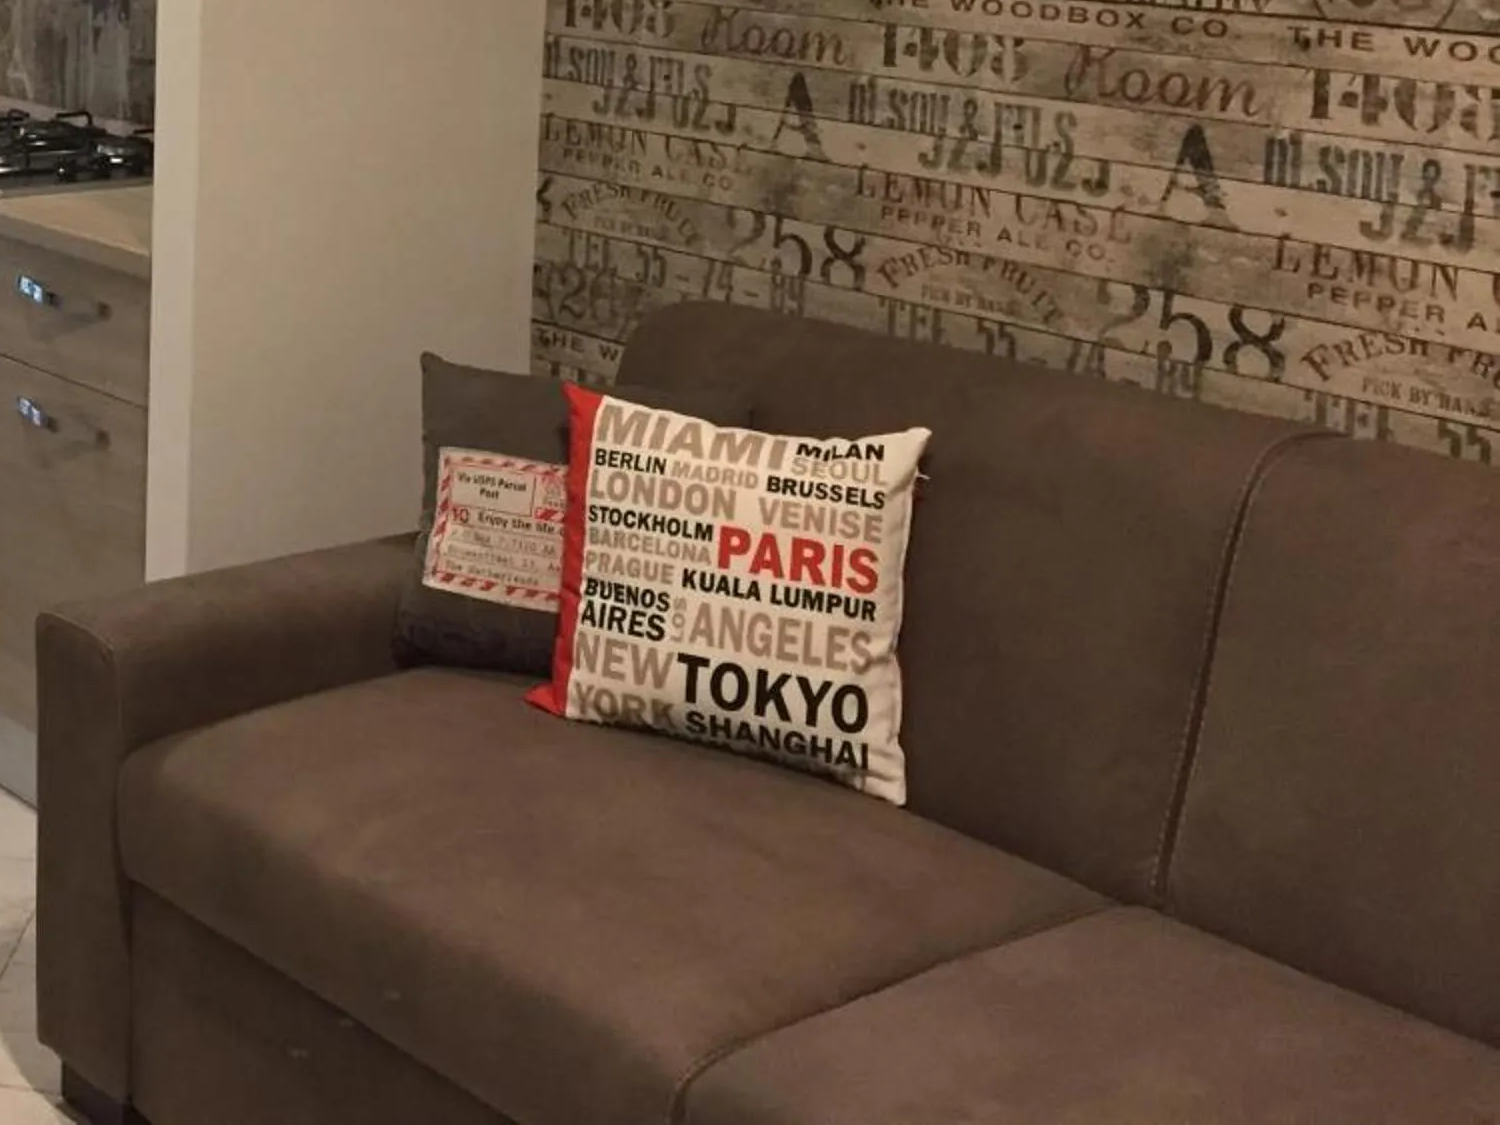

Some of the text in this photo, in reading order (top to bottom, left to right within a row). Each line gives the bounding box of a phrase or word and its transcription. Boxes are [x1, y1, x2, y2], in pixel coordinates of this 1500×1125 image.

[1289, 26, 1377, 57] THE
[1062, 41, 1263, 119] Room
[1159, 118, 1243, 229] A
[1302, 280, 1450, 326] PEPPER
[1091, 275, 1290, 385] 258
[597, 405, 788, 470] MIAMI
[796, 443, 885, 462] MILAN
[594, 448, 759, 490] BERLIN MADRID
[766, 474, 886, 510] BRUSSELS
[790, 455, 887, 487] SEOUL
[477, 511, 508, 529] Enjoy
[512, 518, 532, 530] the
[588, 504, 715, 542] STOCKHOLM
[590, 470, 737, 520] LONDON
[758, 497, 884, 544] VENISE
[585, 551, 675, 585] PRAGUE
[588, 526, 713, 566] BARCELONA
[717, 525, 879, 595] PARIS
[585, 577, 671, 613] BUENOS
[681, 568, 877, 622] KUALA LUMPUR
[581, 599, 666, 643] AIRES
[689, 602, 874, 675] ANGELES
[575, 630, 676, 689] NEW
[573, 681, 676, 727] YORK
[677, 651, 870, 735] TOKYO
[684, 710, 870, 771] SHANGHAI
